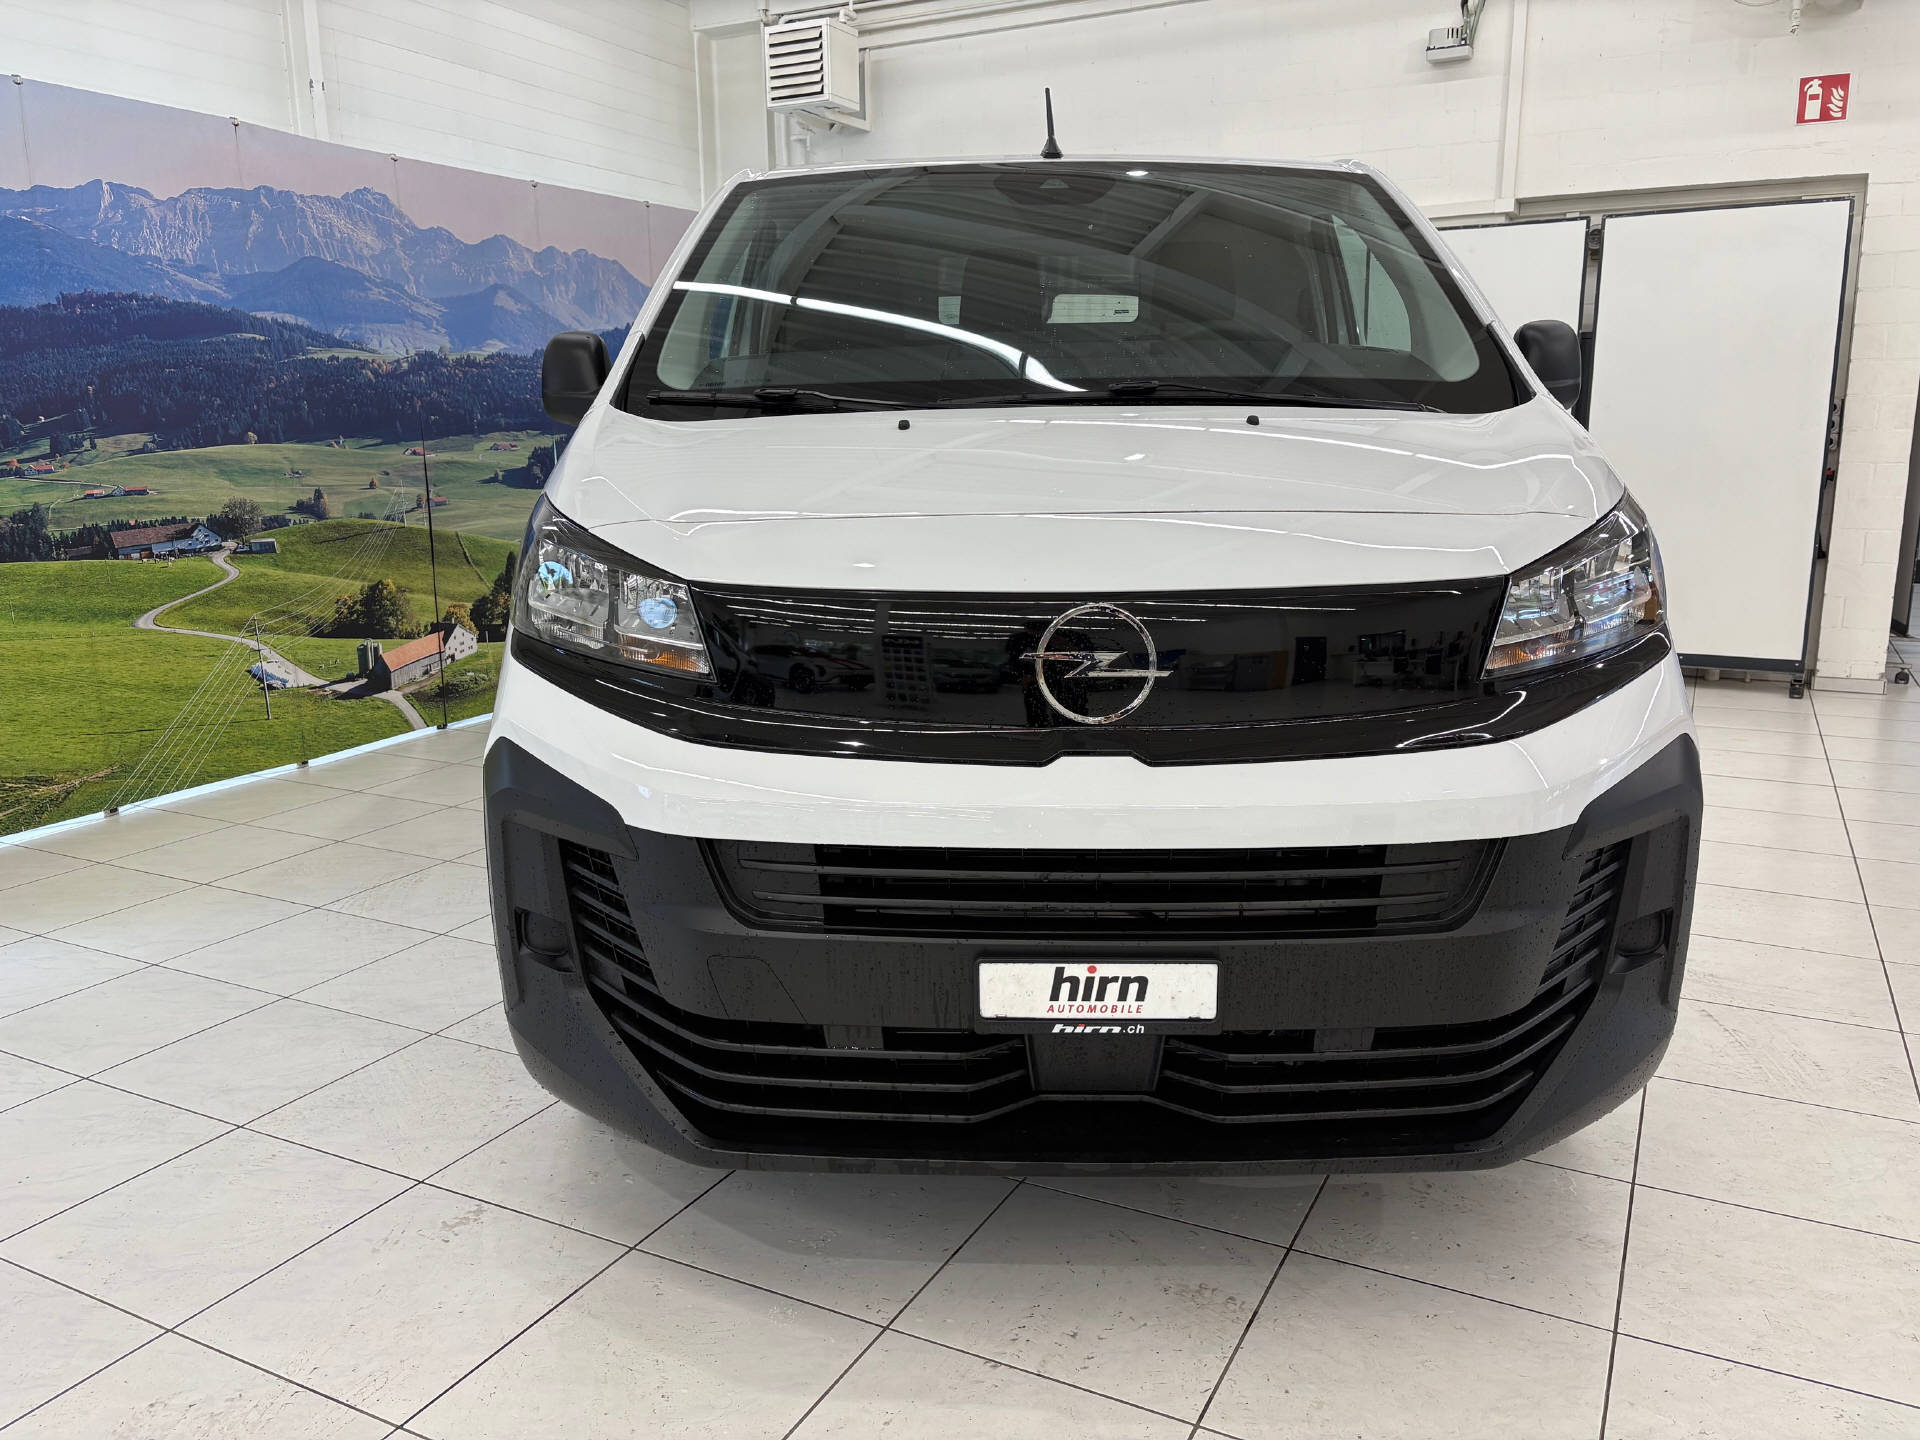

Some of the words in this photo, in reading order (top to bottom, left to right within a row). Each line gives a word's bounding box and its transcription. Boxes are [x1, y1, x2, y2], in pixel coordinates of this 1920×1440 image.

[1049, 965, 1149, 1002] hirn
[1046, 1004, 1144, 1014] AUTOMOBILE
[1051, 1023, 1145, 1034] hirn.ch
